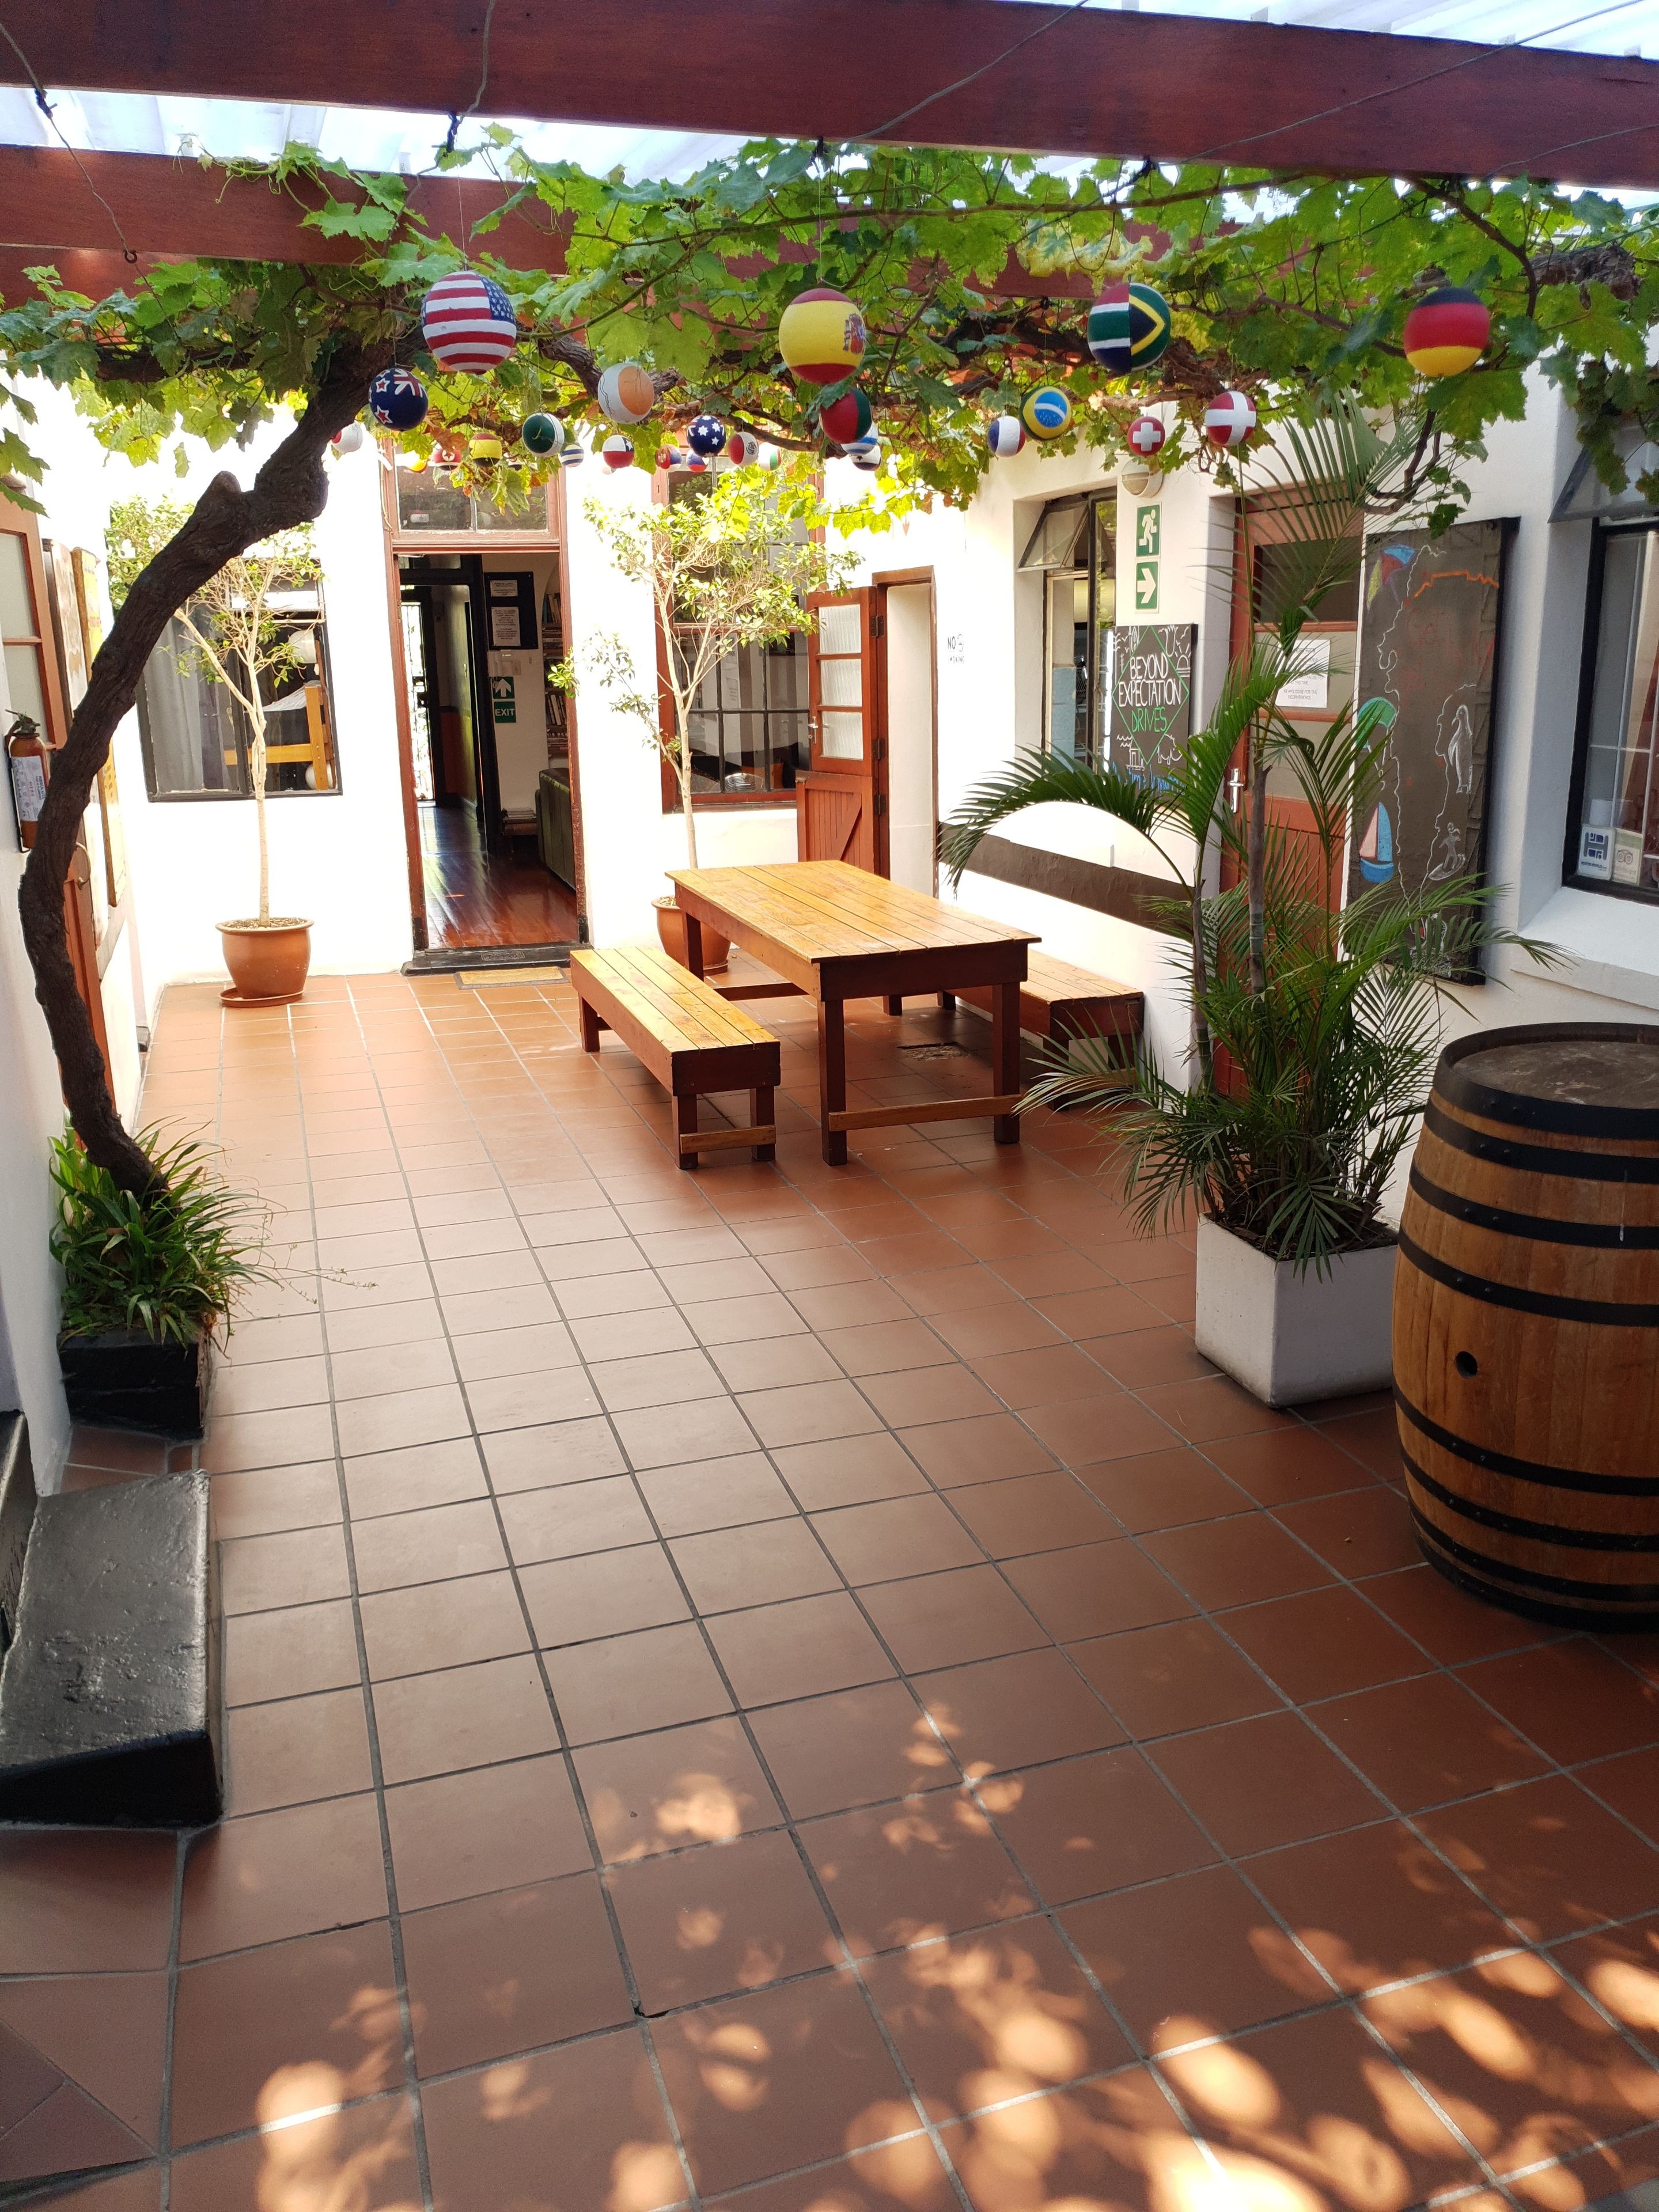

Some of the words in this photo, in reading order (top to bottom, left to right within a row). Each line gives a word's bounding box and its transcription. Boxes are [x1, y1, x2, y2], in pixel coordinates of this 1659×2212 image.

[948, 635, 956, 650] NO
[1130, 652, 1168, 679] BEYOND
[1118, 678, 1181, 707] EXPECTATION
[1131, 706, 1168, 732] DRIVES
